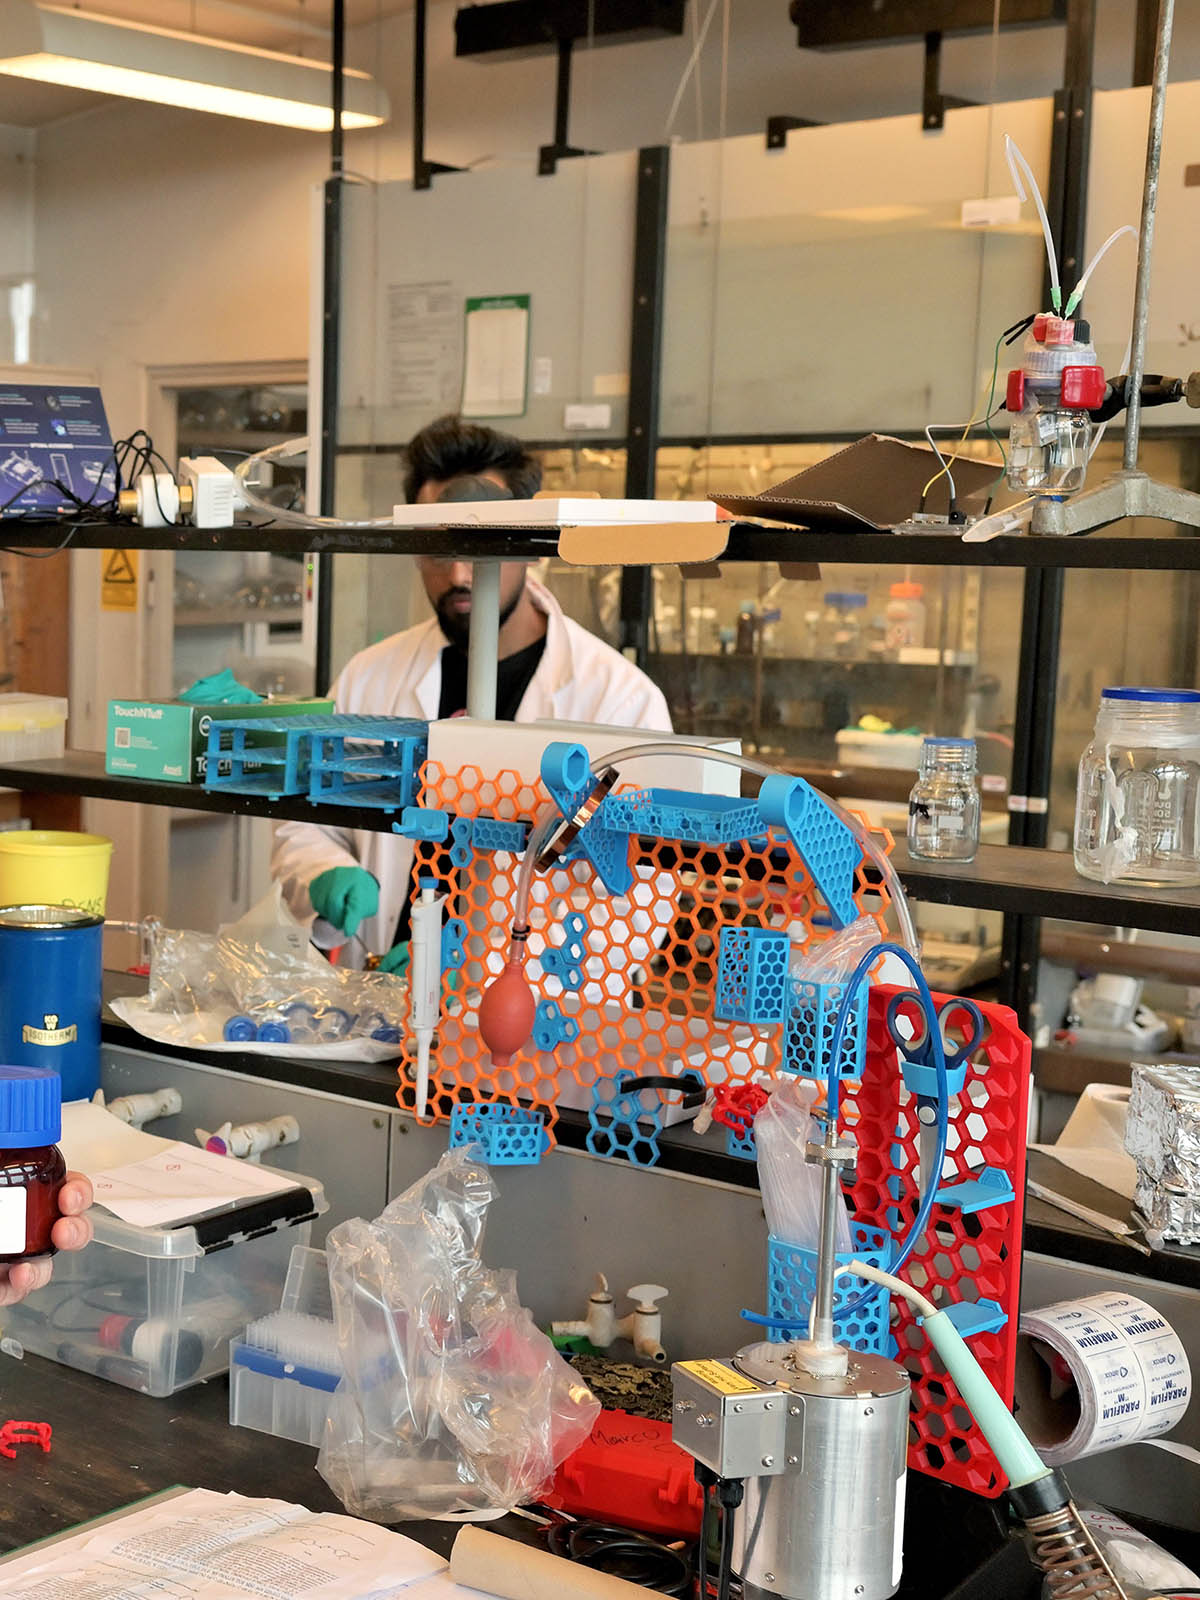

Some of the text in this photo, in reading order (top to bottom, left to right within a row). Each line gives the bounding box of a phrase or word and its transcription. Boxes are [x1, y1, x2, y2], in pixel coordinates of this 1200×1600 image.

[113, 705, 163, 720] TouchNTuff
[29, 1029, 71, 1041] ISOTHERM
[1124, 1318, 1165, 1336] PARAFILM
[1077, 1330, 1118, 1348] PARAFILM
[1150, 1387, 1187, 1406] PARAFILM
[1102, 1400, 1140, 1420] PARAFILM
